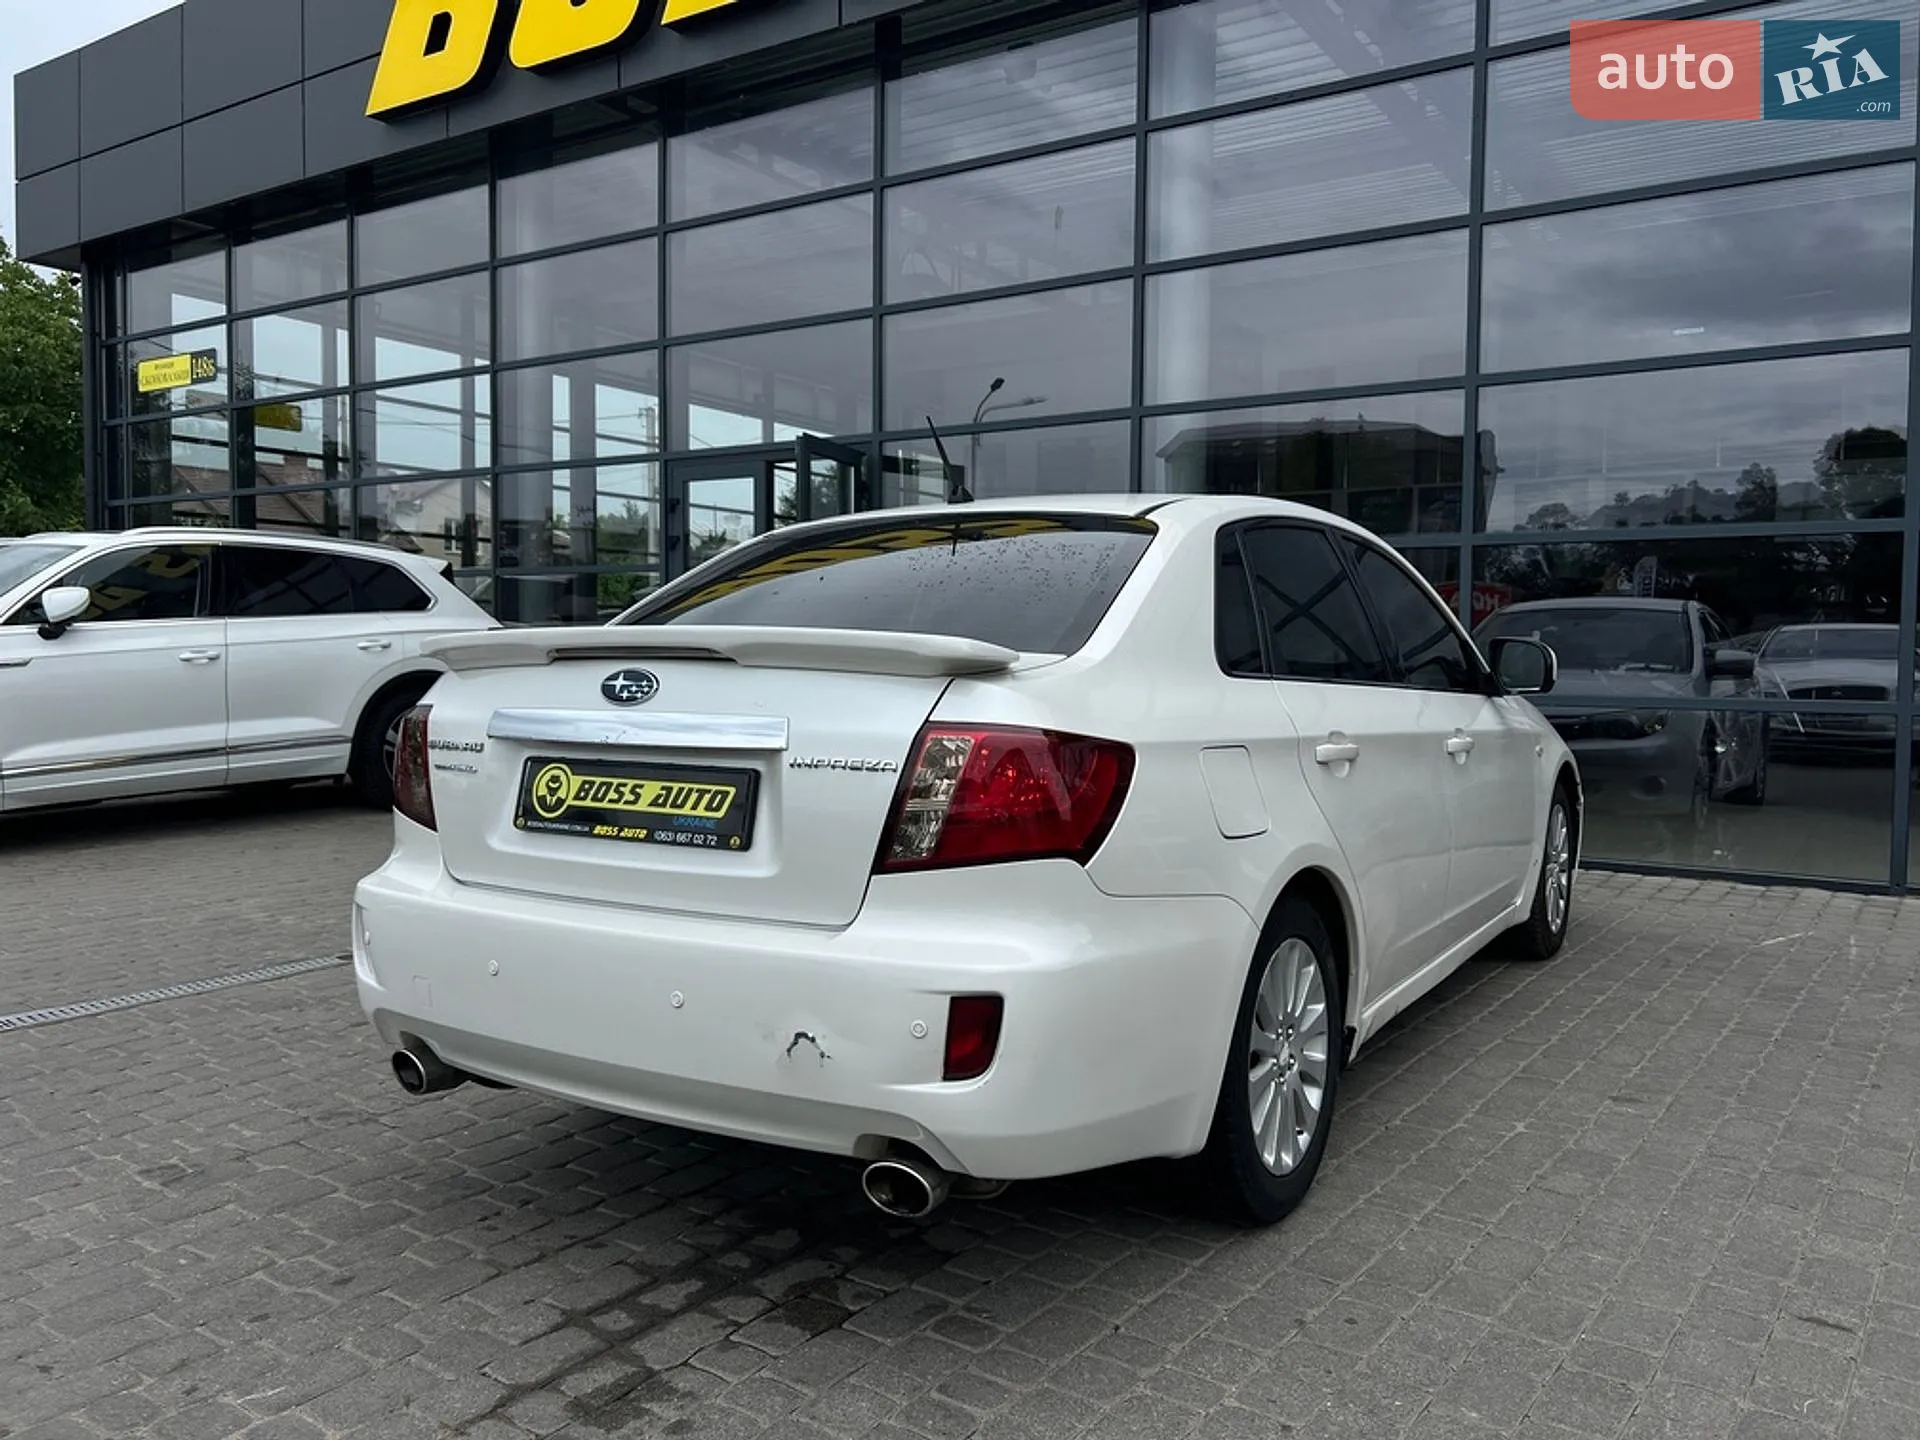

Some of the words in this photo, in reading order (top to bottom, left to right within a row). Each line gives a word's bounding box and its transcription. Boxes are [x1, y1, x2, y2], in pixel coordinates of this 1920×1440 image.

[789, 757, 898, 772] IMPREZA
[574, 780, 644, 805] BOSS
[648, 786, 731, 812] AUTO
[592, 825, 618, 836] BOSS
[619, 827, 648, 839] AUTO
[693, 833, 705, 845] 02
[706, 834, 718, 846] 72
